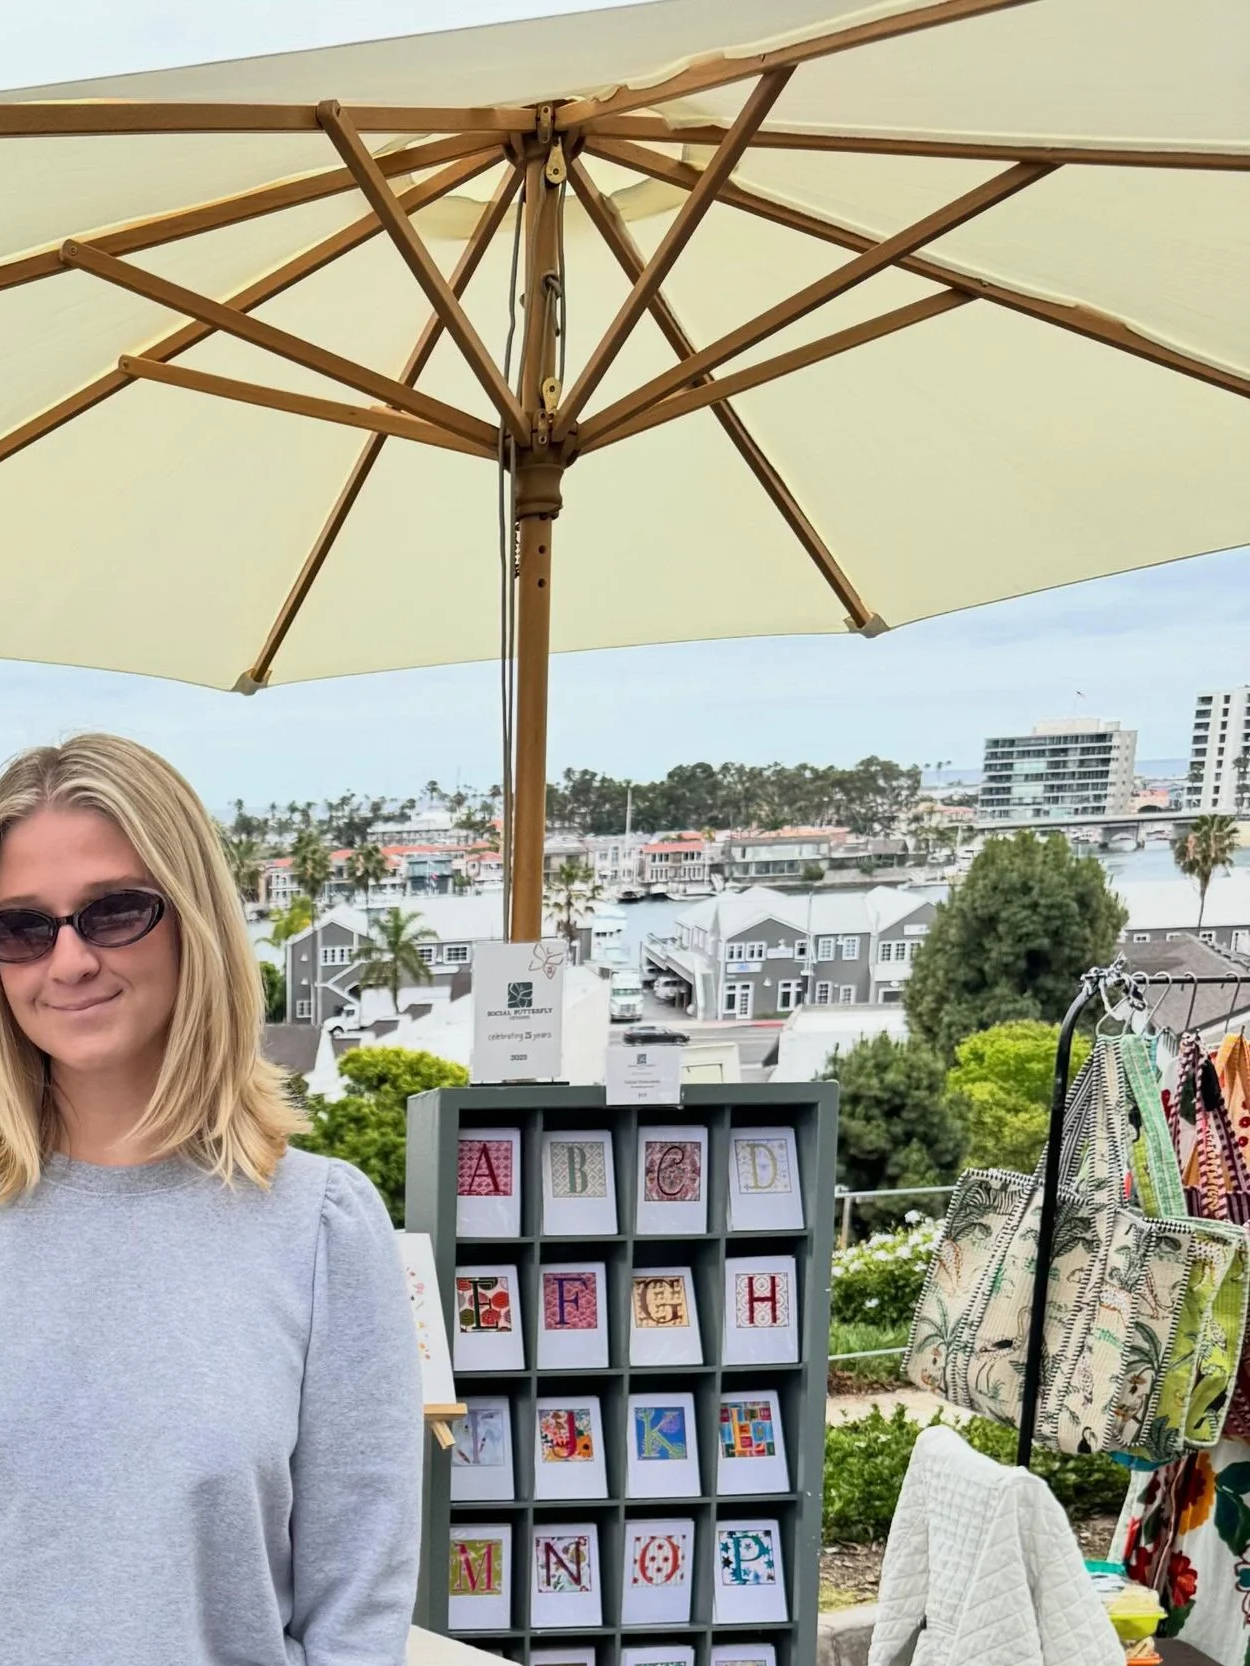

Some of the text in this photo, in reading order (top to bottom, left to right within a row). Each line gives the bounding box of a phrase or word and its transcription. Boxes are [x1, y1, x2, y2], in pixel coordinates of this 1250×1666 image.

[514, 1007, 553, 1016] BUTTERFLY
[488, 1032, 523, 1042] celebrating
[533, 1033, 552, 1042] years
[461, 1143, 510, 1193] A
[567, 1144, 589, 1193] B
[656, 1146, 685, 1196] C
[746, 1143, 778, 1190] D
[468, 1279, 500, 1330] E
[553, 1277, 589, 1326] F
[639, 1278, 683, 1324] G
[748, 1275, 779, 1324] H
[552, 1412, 578, 1460] J
[638, 1408, 686, 1458] K
[453, 1542, 500, 1592] M
[544, 1541, 581, 1587] N
[638, 1537, 680, 1585] O
[732, 1535, 766, 1585] P
